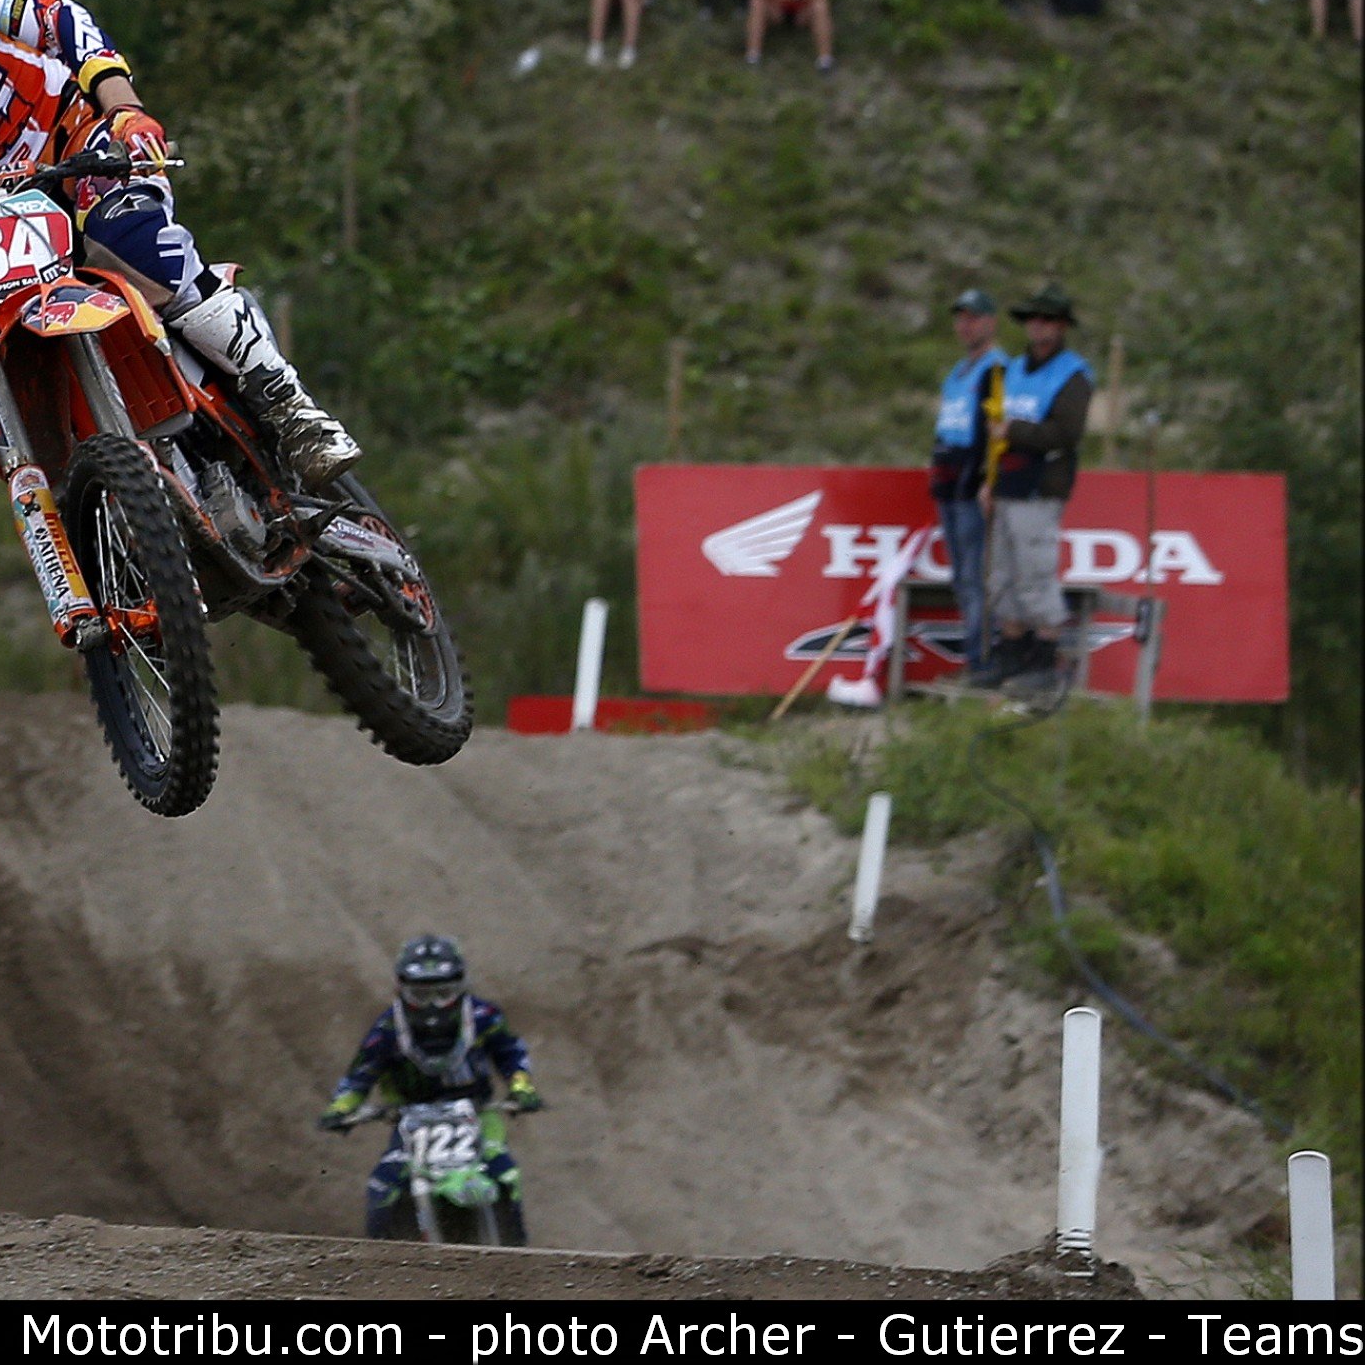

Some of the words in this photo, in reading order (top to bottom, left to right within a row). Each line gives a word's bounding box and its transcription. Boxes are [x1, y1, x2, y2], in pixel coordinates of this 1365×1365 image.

[38, 540, 70, 599] ATHENA
[821, 523, 1226, 586] HDA
[412, 1123, 479, 1166] 122
